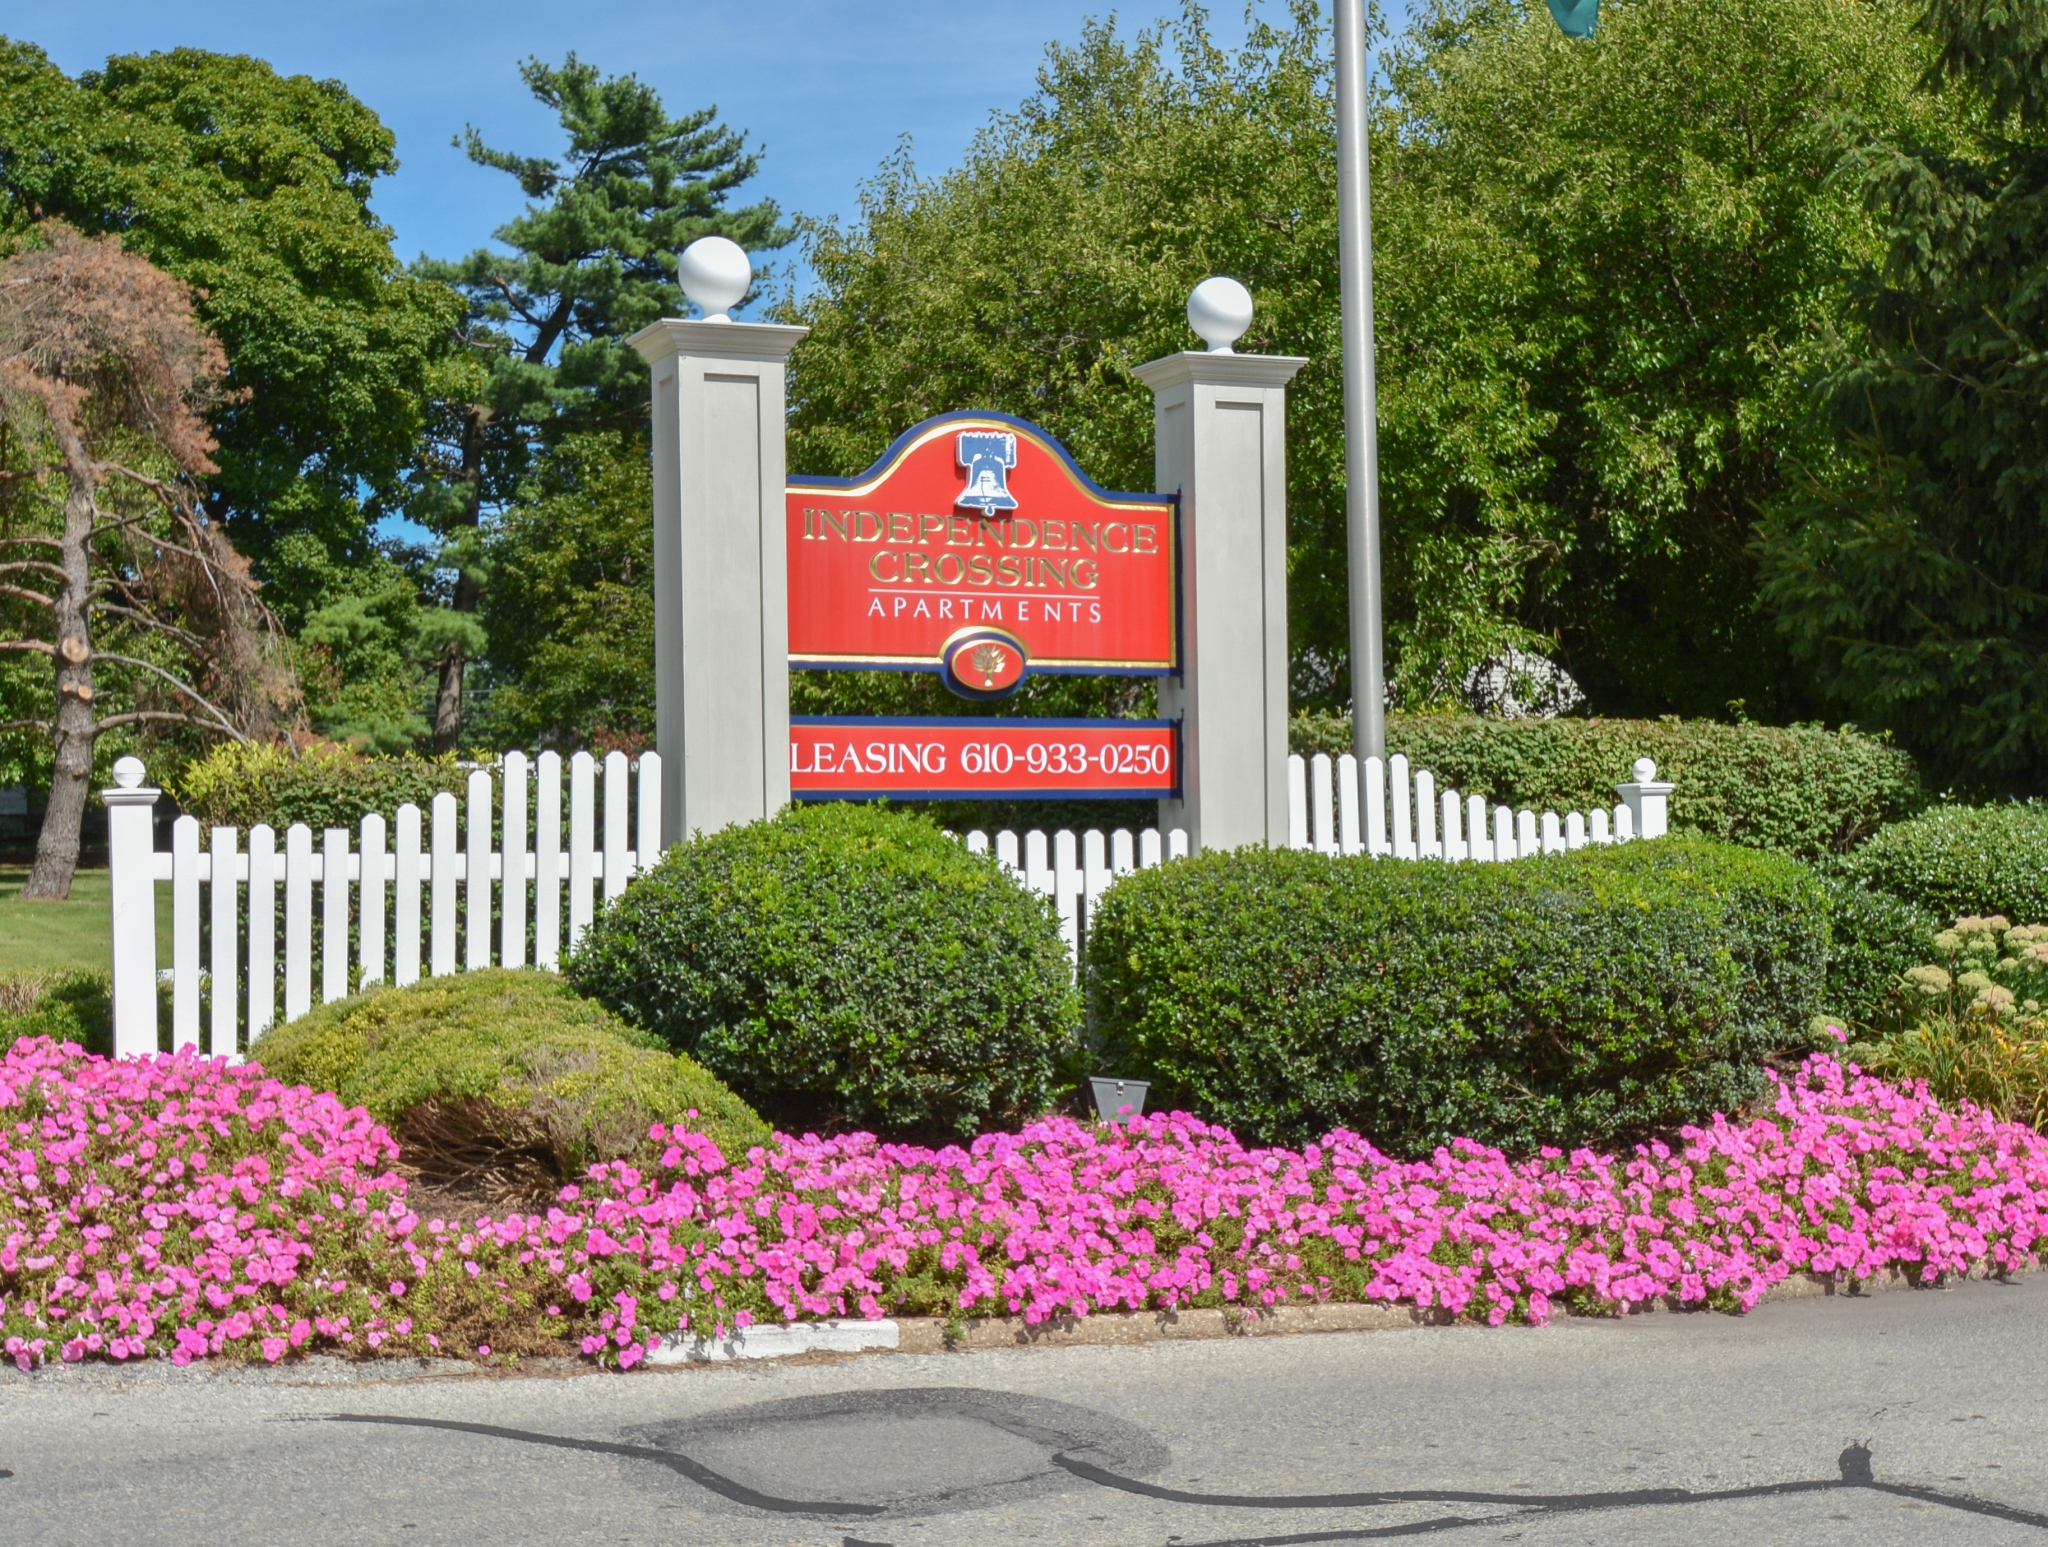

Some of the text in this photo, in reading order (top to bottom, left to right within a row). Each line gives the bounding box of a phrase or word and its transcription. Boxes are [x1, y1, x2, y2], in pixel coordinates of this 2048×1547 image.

[802, 508, 1158, 554] INDEPENDENCE
[869, 550, 1099, 590] CROSSING
[868, 597, 1101, 623] APARTMENTS
[790, 742, 1169, 774] LEASING 610-933-0250
